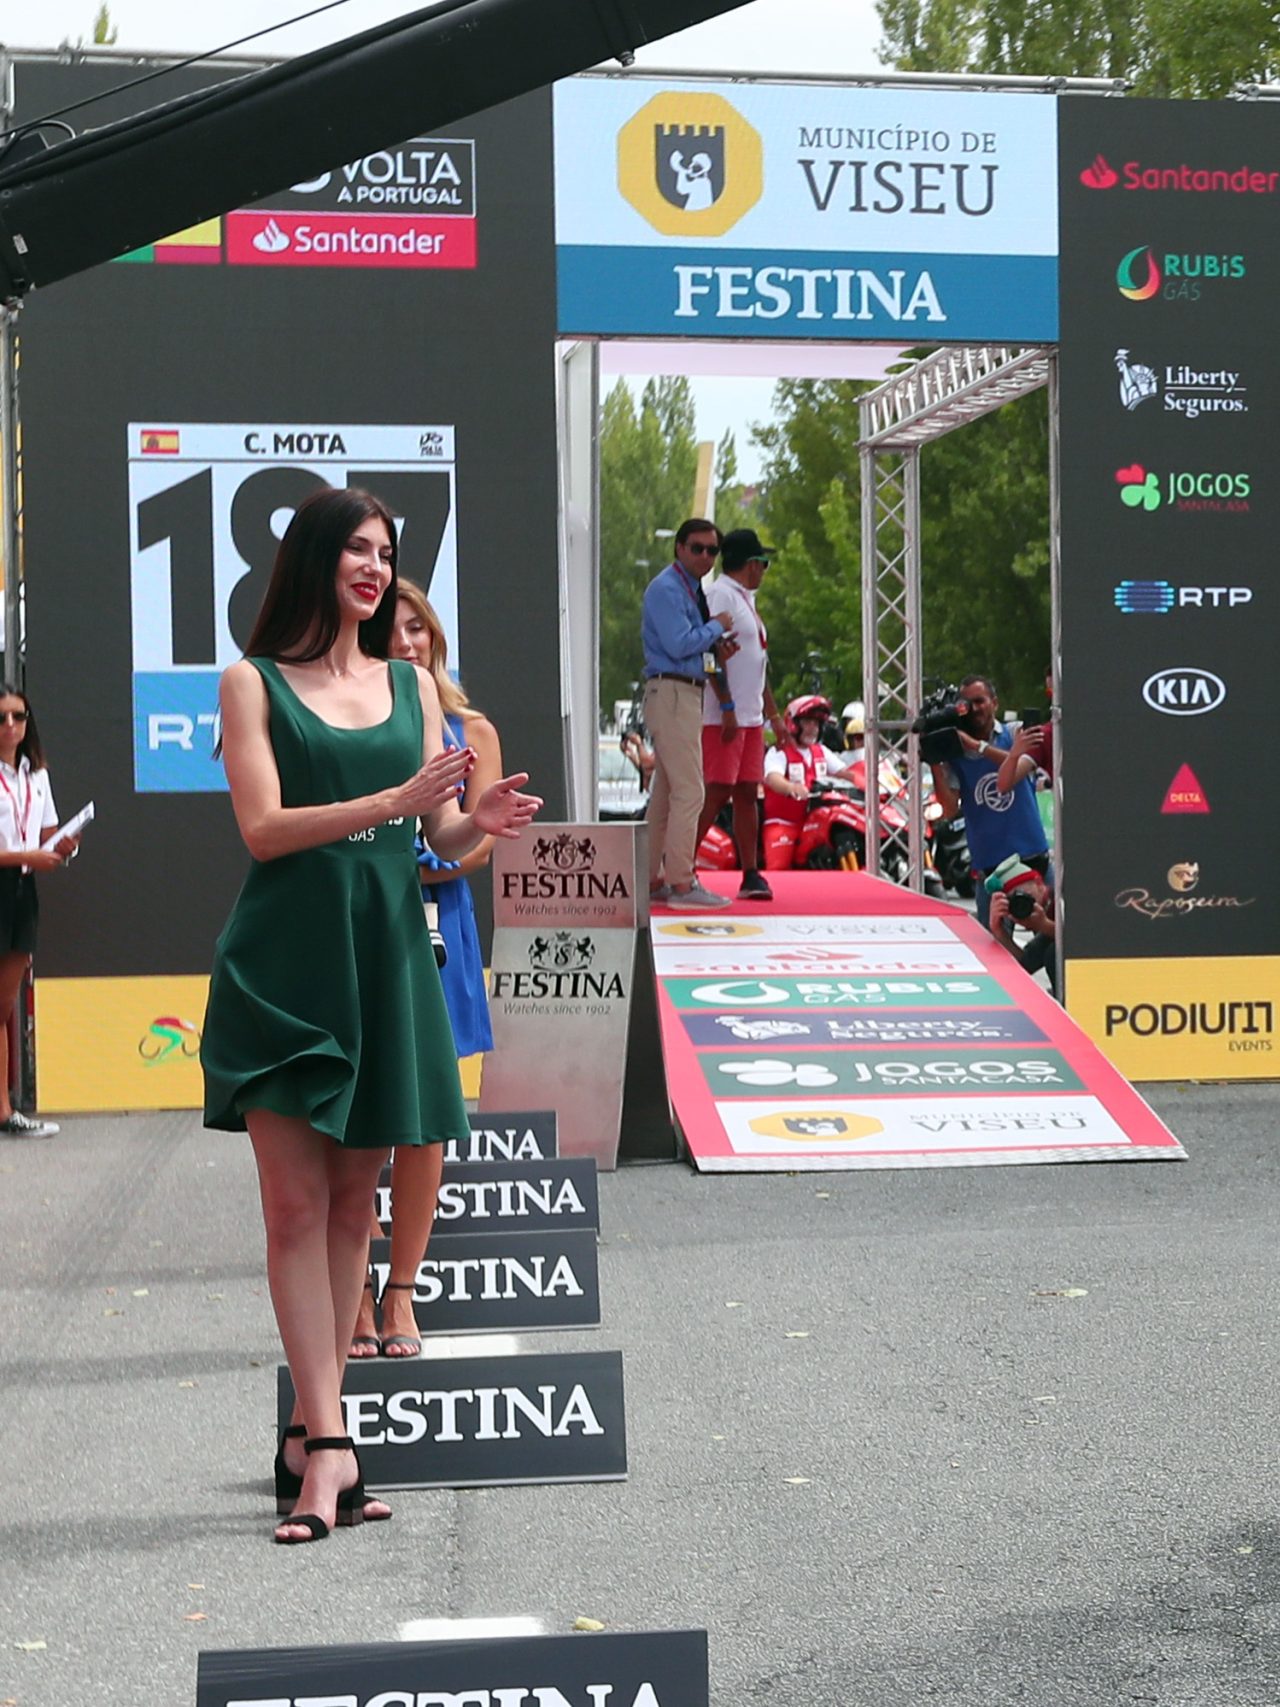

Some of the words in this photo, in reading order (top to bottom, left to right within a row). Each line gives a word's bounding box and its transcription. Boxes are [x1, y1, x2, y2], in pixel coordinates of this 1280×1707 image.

[798, 123, 950, 153] MUNICÍPIO
[962, 132, 998, 154] DE
[341, 150, 461, 185] VOLTA
[1122, 160, 1280, 194] Santander
[337, 186, 352, 203] A
[356, 186, 463, 206] PORTUGAL
[798, 159, 1000, 217] VISEU
[294, 226, 446, 255] Santander
[673, 265, 948, 322] FESTINA
[1164, 366, 1240, 393] Liberty
[243, 433, 266, 454] C.
[272, 433, 348, 455] MOTA
[1167, 472, 1251, 505] JOGOS
[1178, 586, 1253, 607] RTP
[1157, 679, 1212, 704] KIA
[148, 713, 222, 751] RT
[502, 872, 630, 899] FESTINA
[514, 902, 559, 916] Watches
[562, 902, 589, 915] since
[674, 961, 964, 972] Santander
[492, 971, 626, 999] FESTINA
[503, 1001, 550, 1016] Watches
[554, 1002, 581, 1015] since
[827, 1020, 983, 1031] Liberty
[1228, 1038, 1273, 1052] EVENTS
[855, 1061, 1057, 1082] JOGOS
[911, 1116, 1088, 1134] VISEU
[340, 1383, 606, 1446] ESTINA
